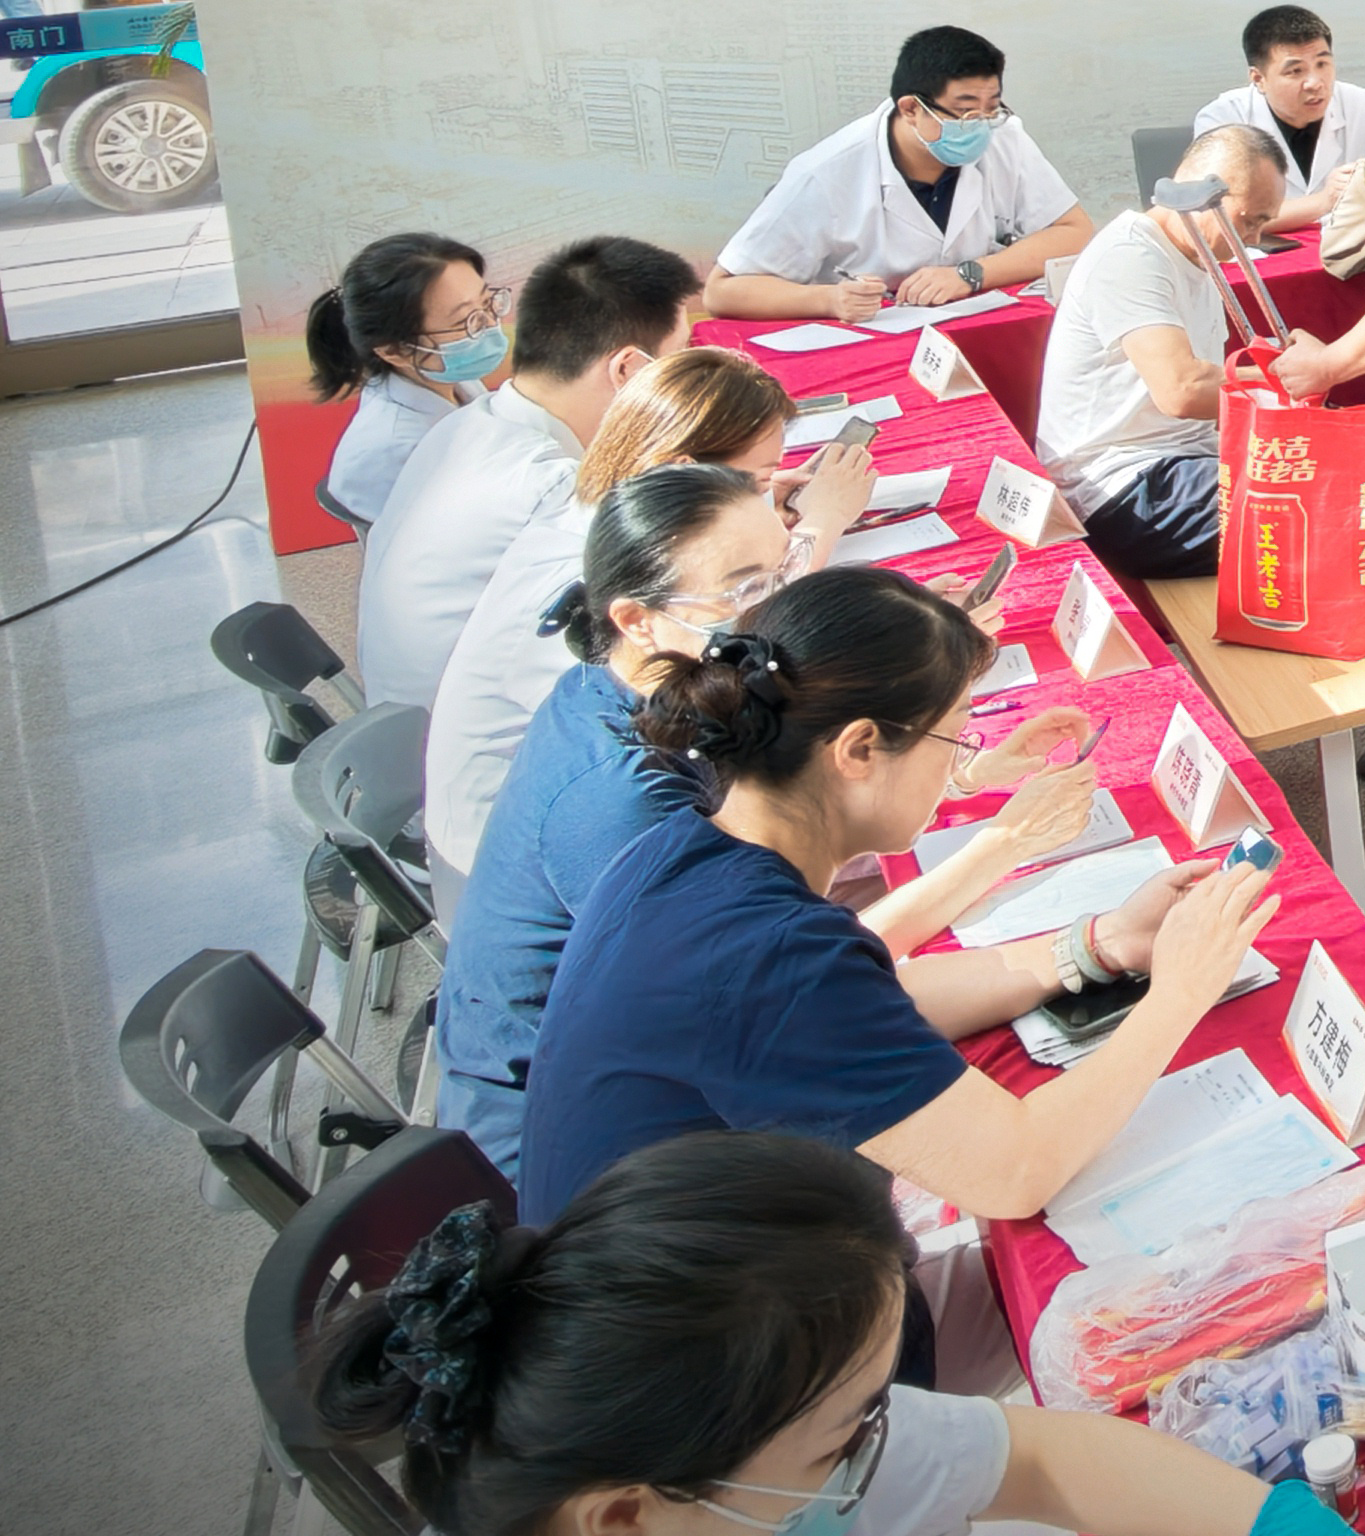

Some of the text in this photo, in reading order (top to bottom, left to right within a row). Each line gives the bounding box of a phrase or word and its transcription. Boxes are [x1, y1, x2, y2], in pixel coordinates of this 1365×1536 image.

[7, 26, 65, 51] 南门
[1257, 522, 1282, 609] 王老吉
